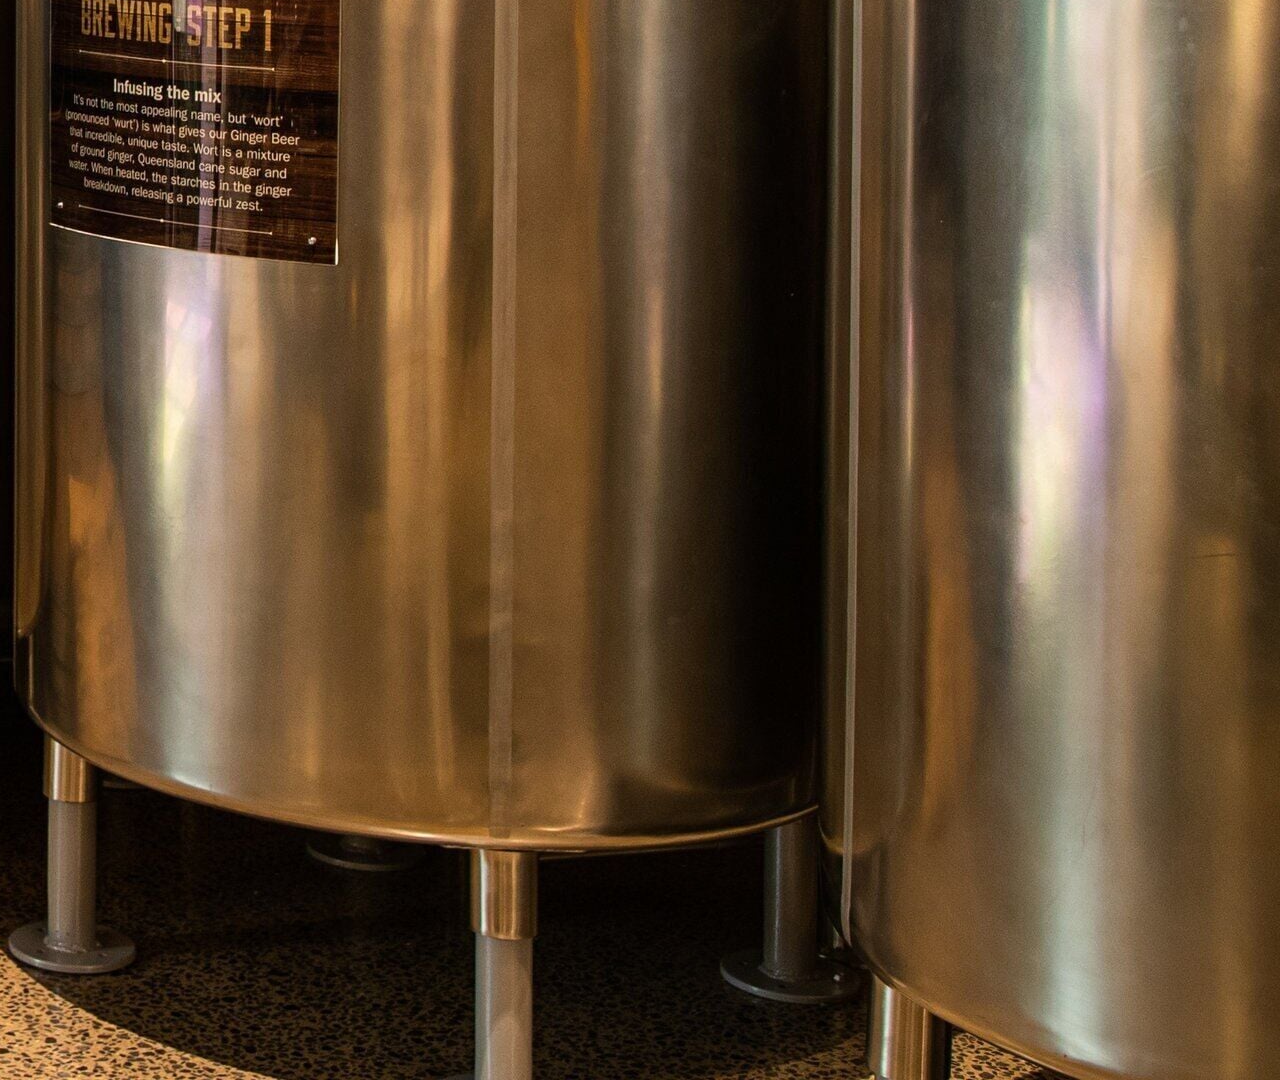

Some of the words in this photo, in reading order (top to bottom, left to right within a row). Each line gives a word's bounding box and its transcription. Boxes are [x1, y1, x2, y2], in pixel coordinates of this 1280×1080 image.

[187, 4, 251, 50] STEP
[264, 9, 272, 52] 1
[113, 78, 164, 100] Infusing
[167, 85, 190, 101] the
[195, 88, 222, 104] mix
[86, 97, 98, 108] not
[100, 99, 114, 111] the
[116, 102, 139, 114] most
[141, 106, 188, 122] appealing
[190, 111, 224, 123] name,
[228, 112, 247, 124] but
[69, 126, 83, 138] that
[128, 136, 158, 150] unique
[161, 140, 190, 153] taste.
[193, 142, 218, 156] Wort
[222, 146, 231, 157] is
[235, 149, 243, 158] a
[246, 149, 291, 163] mixture
[142, 120, 150, 131] is
[153, 122, 176, 135] what
[179, 125, 206, 139] gives
[209, 129, 227, 140] our
[231, 129, 268, 145] Ginger
[271, 132, 300, 146] Beer
[71, 143, 78, 153] of
[80, 144, 105, 158] ground
[138, 152, 195, 170] Queensland
[198, 163, 225, 173] cane
[229, 165, 261, 179] sugar
[264, 168, 287, 179] and
[91, 161, 113, 176] When
[152, 171, 167, 184] the
[170, 174, 216, 189] starches
[219, 180, 229, 191] in
[233, 181, 251, 193] the
[255, 184, 292, 199] ginger
[131, 186, 174, 204] releasing
[176, 194, 183, 203] a
[186, 194, 232, 209] powerful
[236, 200, 263, 212] zest.
